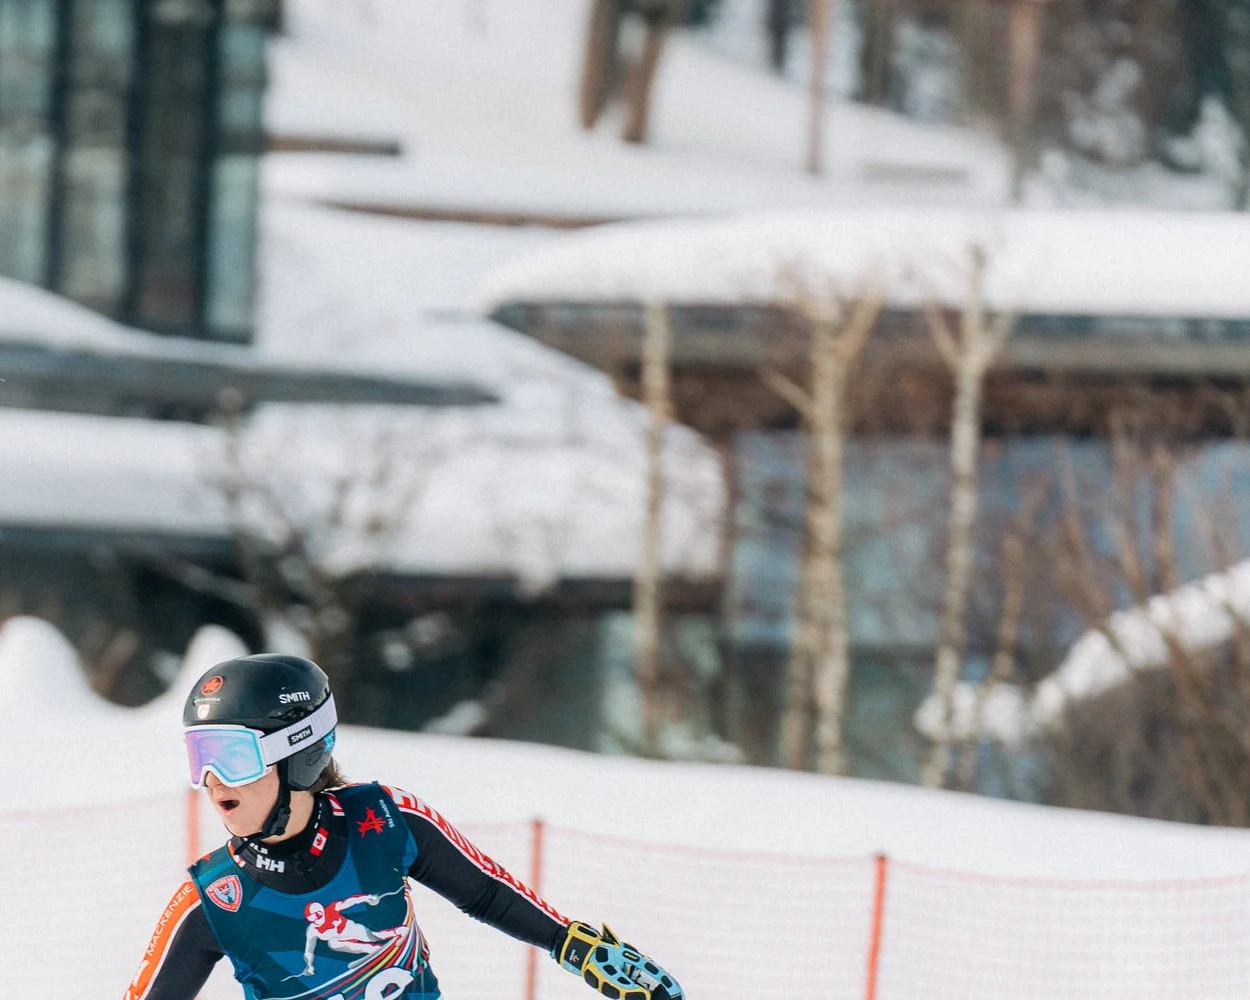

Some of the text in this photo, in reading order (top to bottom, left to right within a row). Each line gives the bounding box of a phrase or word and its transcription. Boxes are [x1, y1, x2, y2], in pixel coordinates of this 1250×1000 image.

[279, 690, 311, 704] SMITH
[291, 729, 311, 743] SMITH
[256, 854, 285, 873] HH
[147, 884, 194, 957] MACKENZIE
